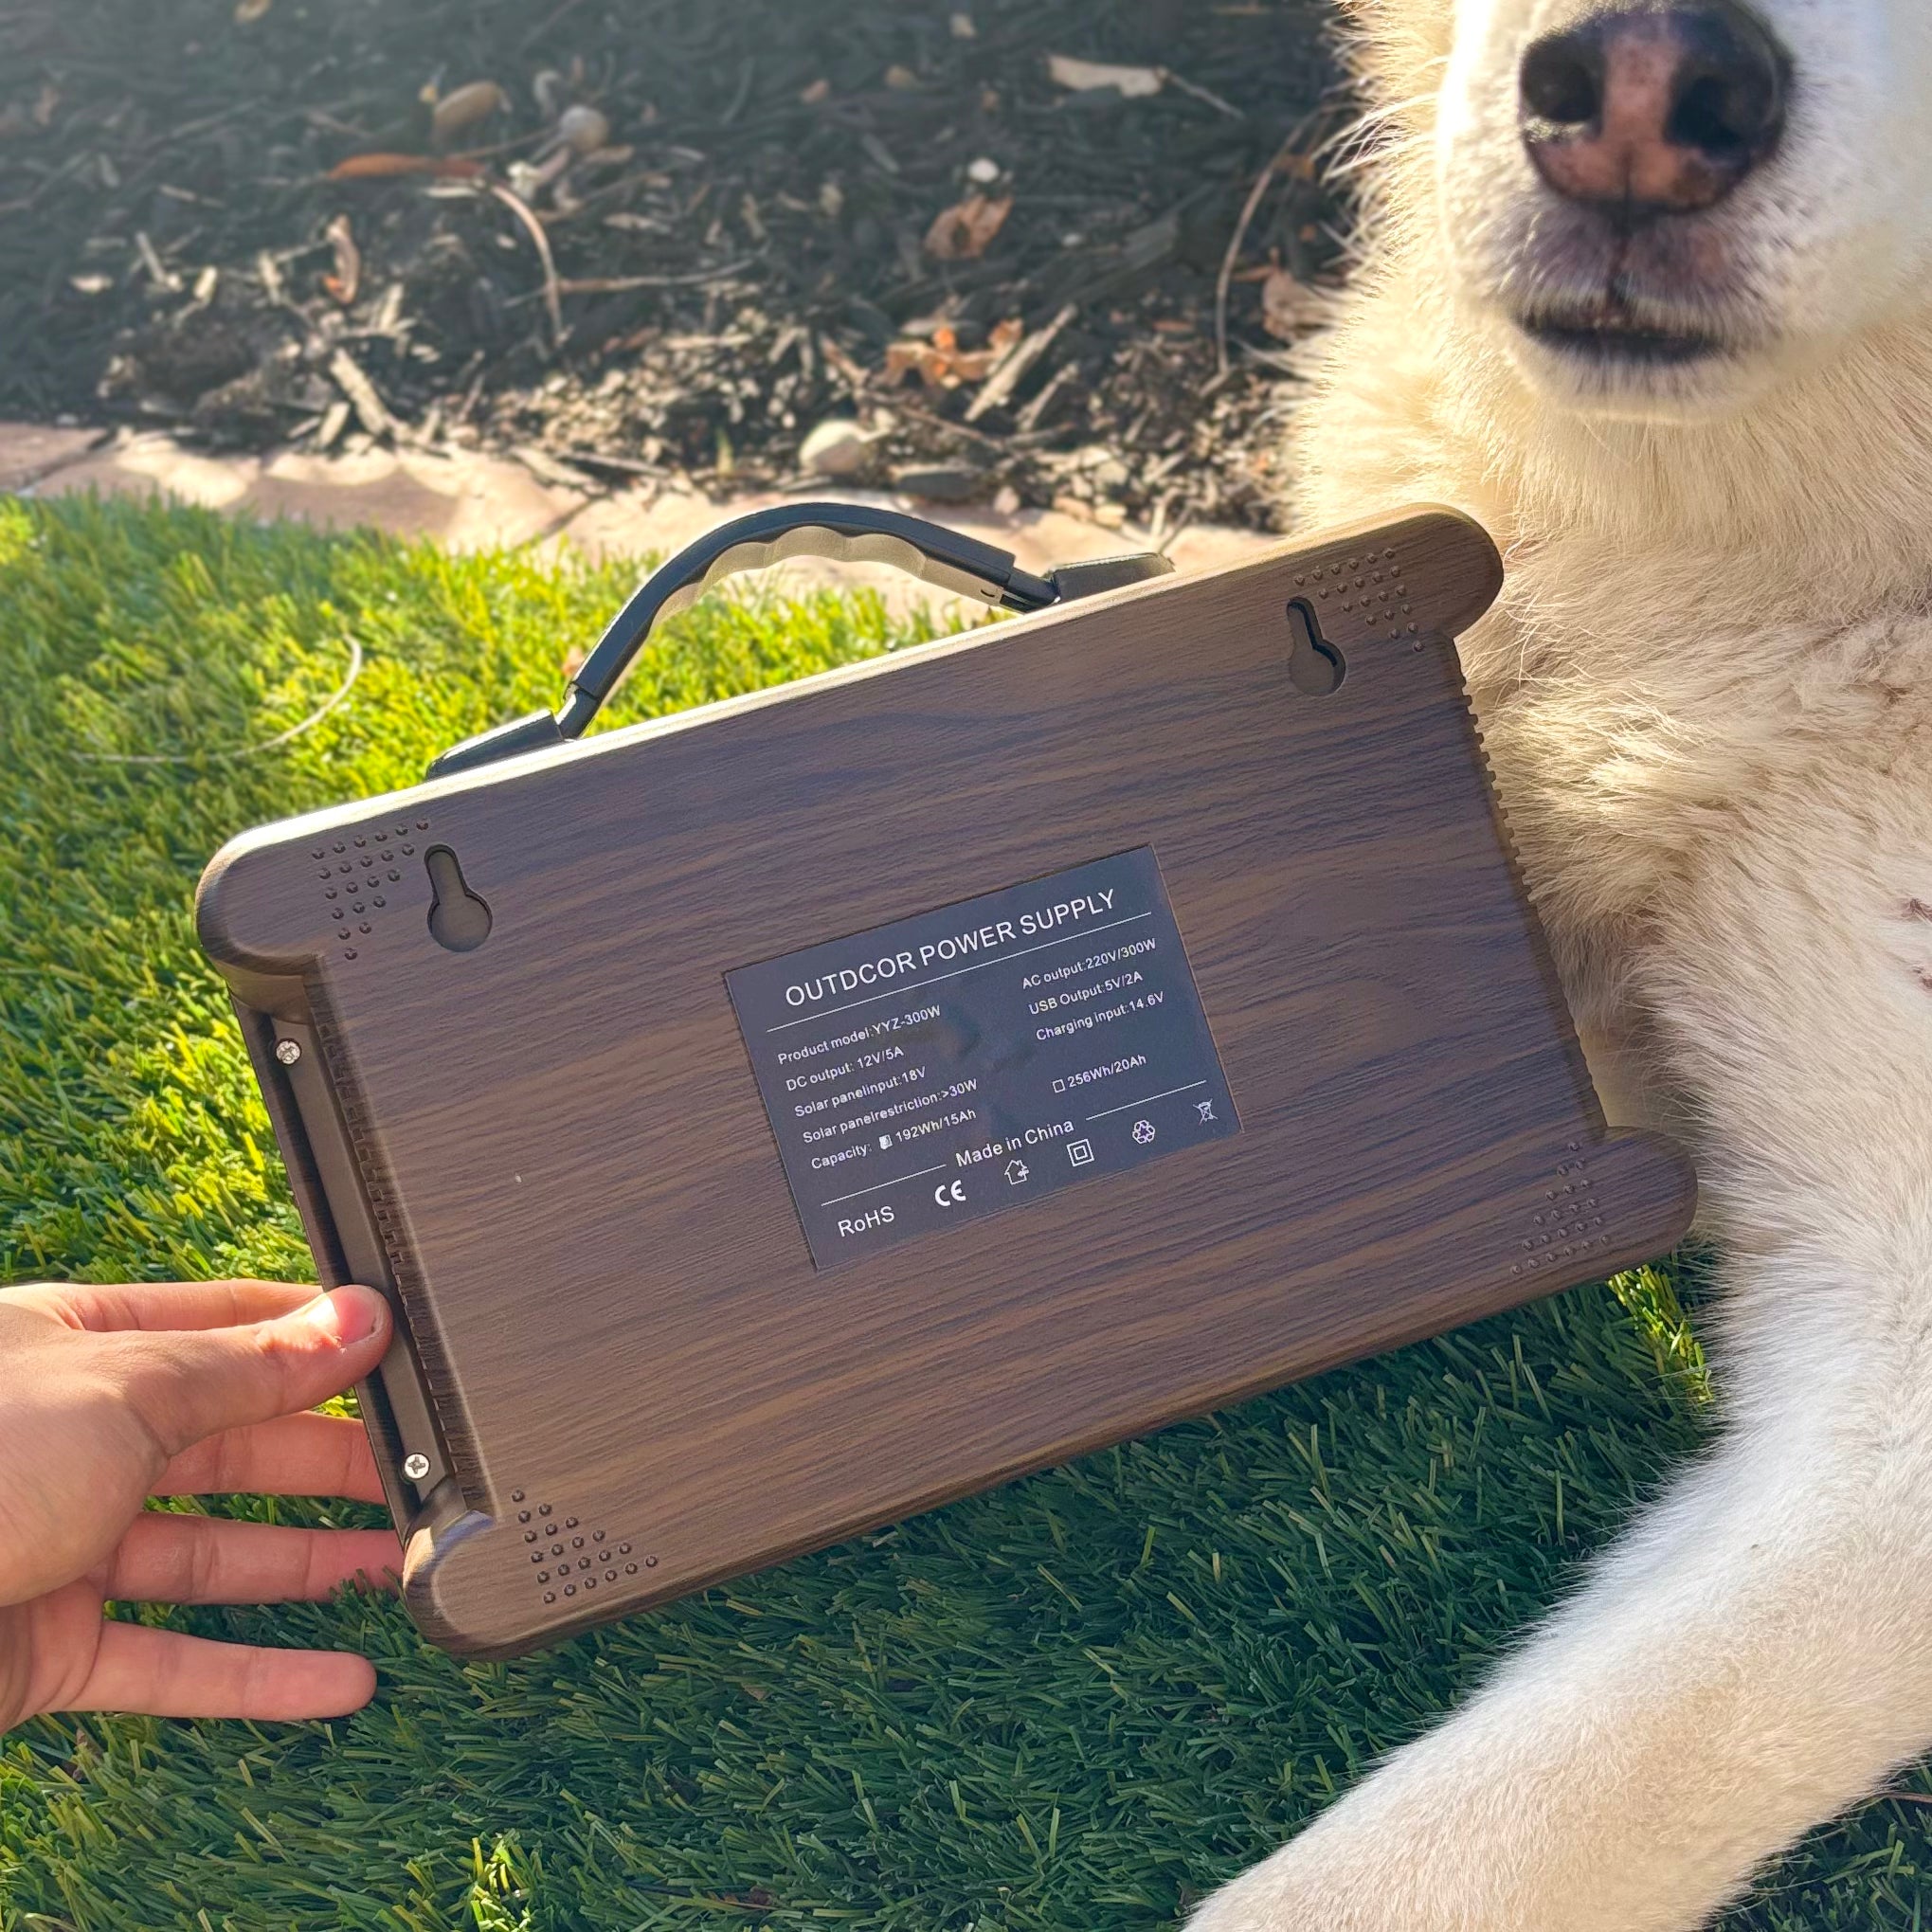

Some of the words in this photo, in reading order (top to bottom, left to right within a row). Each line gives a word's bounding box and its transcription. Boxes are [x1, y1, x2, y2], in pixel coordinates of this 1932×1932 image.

[785, 951, 916, 1005] OUTDCOR
[919, 921, 1016, 966] POWER
[1020, 889, 1114, 934] SUPPLY
[1022, 974, 1041, 989] AC
[1029, 998, 1057, 1015] USB
[1036, 1015, 1093, 1041] Charging
[778, 1040, 829, 1064] Product
[785, 1075, 807, 1092] DC
[809, 1062, 855, 1083] output:
[857, 1046, 904, 1069] 12V/5A
[1067, 1054, 1147, 1088] 256Wh/20Ah
[794, 1099, 829, 1117] Solar
[803, 1125, 837, 1144] Solar
[811, 1142, 872, 1169] Capacity:
[895, 1108, 976, 1143] 192Wh/15Ah
[955, 1141, 1002, 1167] Made
[1005, 1135, 1022, 1151] in
[1024, 1120, 1074, 1145] China
[934, 1180, 966, 1207] CE
[838, 1205, 894, 1237] RoHS
